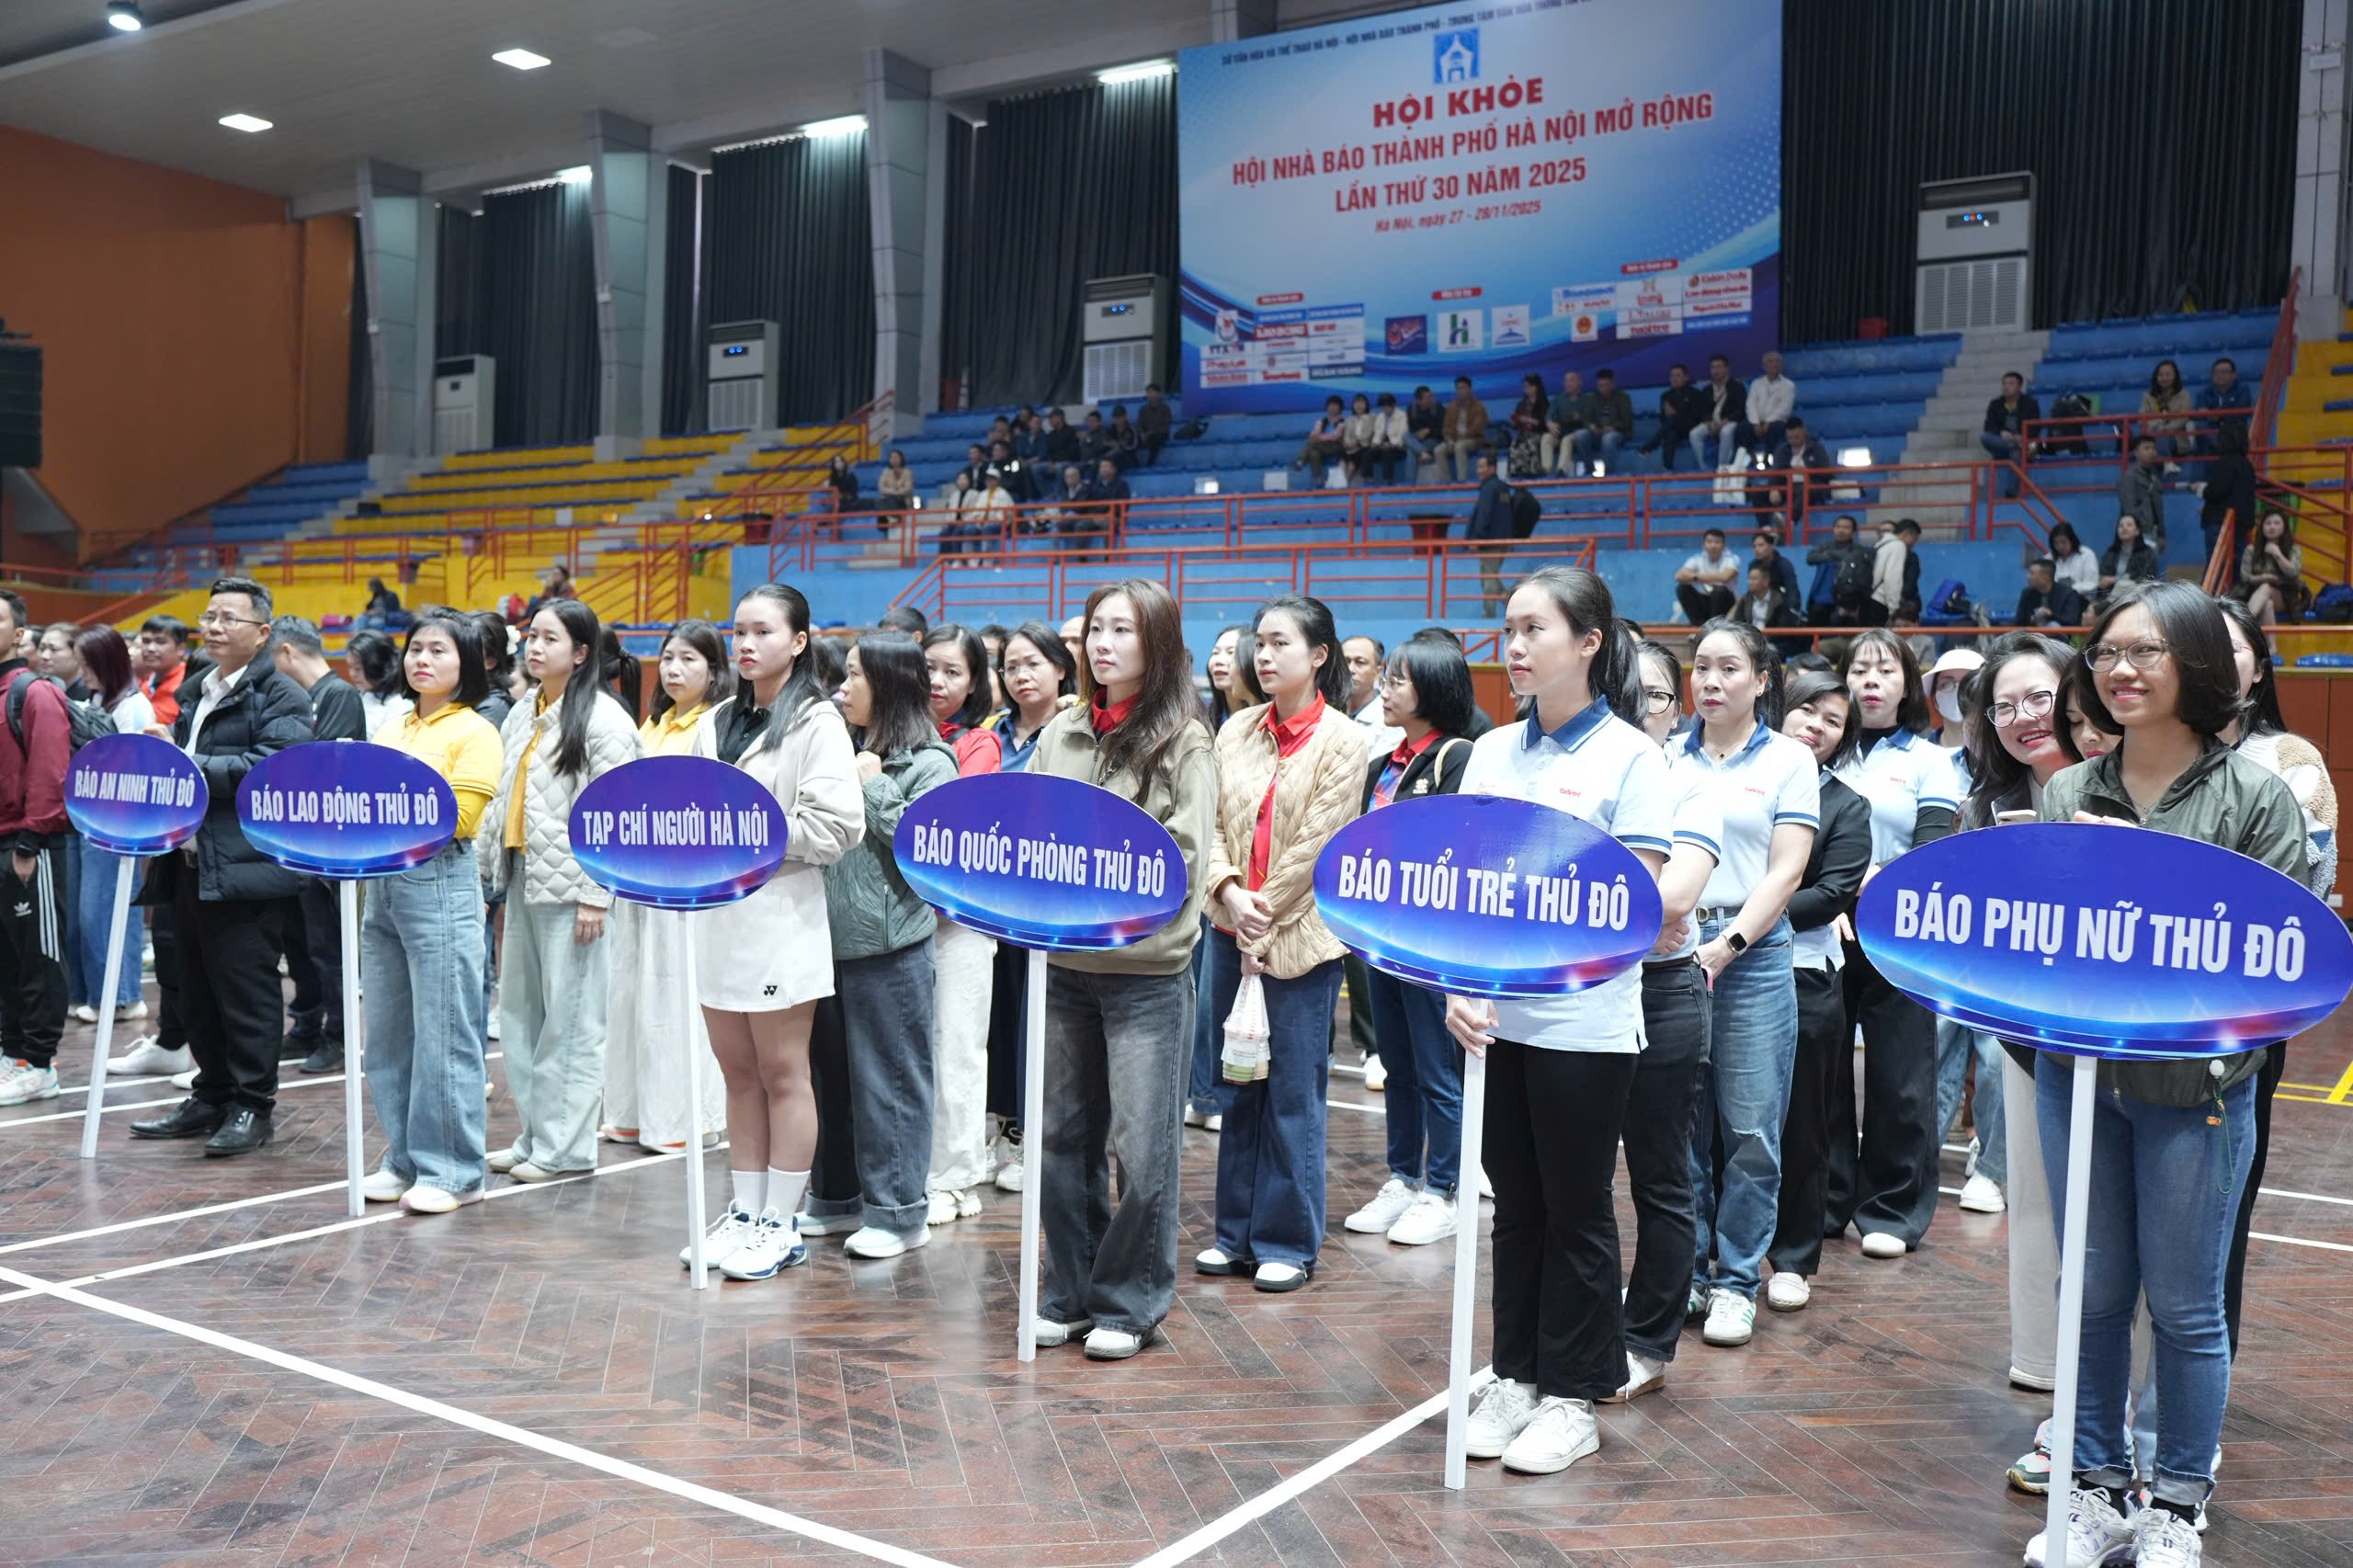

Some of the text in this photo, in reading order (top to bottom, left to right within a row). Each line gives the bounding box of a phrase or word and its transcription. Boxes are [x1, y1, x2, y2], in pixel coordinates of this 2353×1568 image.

[1373, 74, 1543, 130] HỘI KHỎE
[1233, 93, 1712, 188] HỘI NHÀ BÁO THÀNH PHỐ HÀ NỘI MỞ RỘNG
[1336, 157, 1586, 212] LẦN THỨ 30 NĂM 2025
[1449, 210, 1464, 224] 27
[75, 765, 195, 807] BÁO AN NINH THỦ ĐÔ
[251, 782, 438, 831] BÁO LAO ĐỘNG THỦ ĐÔ
[582, 801, 768, 854] TẠP CHÍ NGƯỜI HÀ NỘI
[914, 818, 1165, 898] BÁO QUỐC PHÒNG THỦ ĐÔ
[1337, 847, 1630, 931] BÁO TUỔI TRẺ THỦ ĐÔ
[1894, 881, 2305, 982] BÁO PHỤ NỮ THỦ ĐÔ
